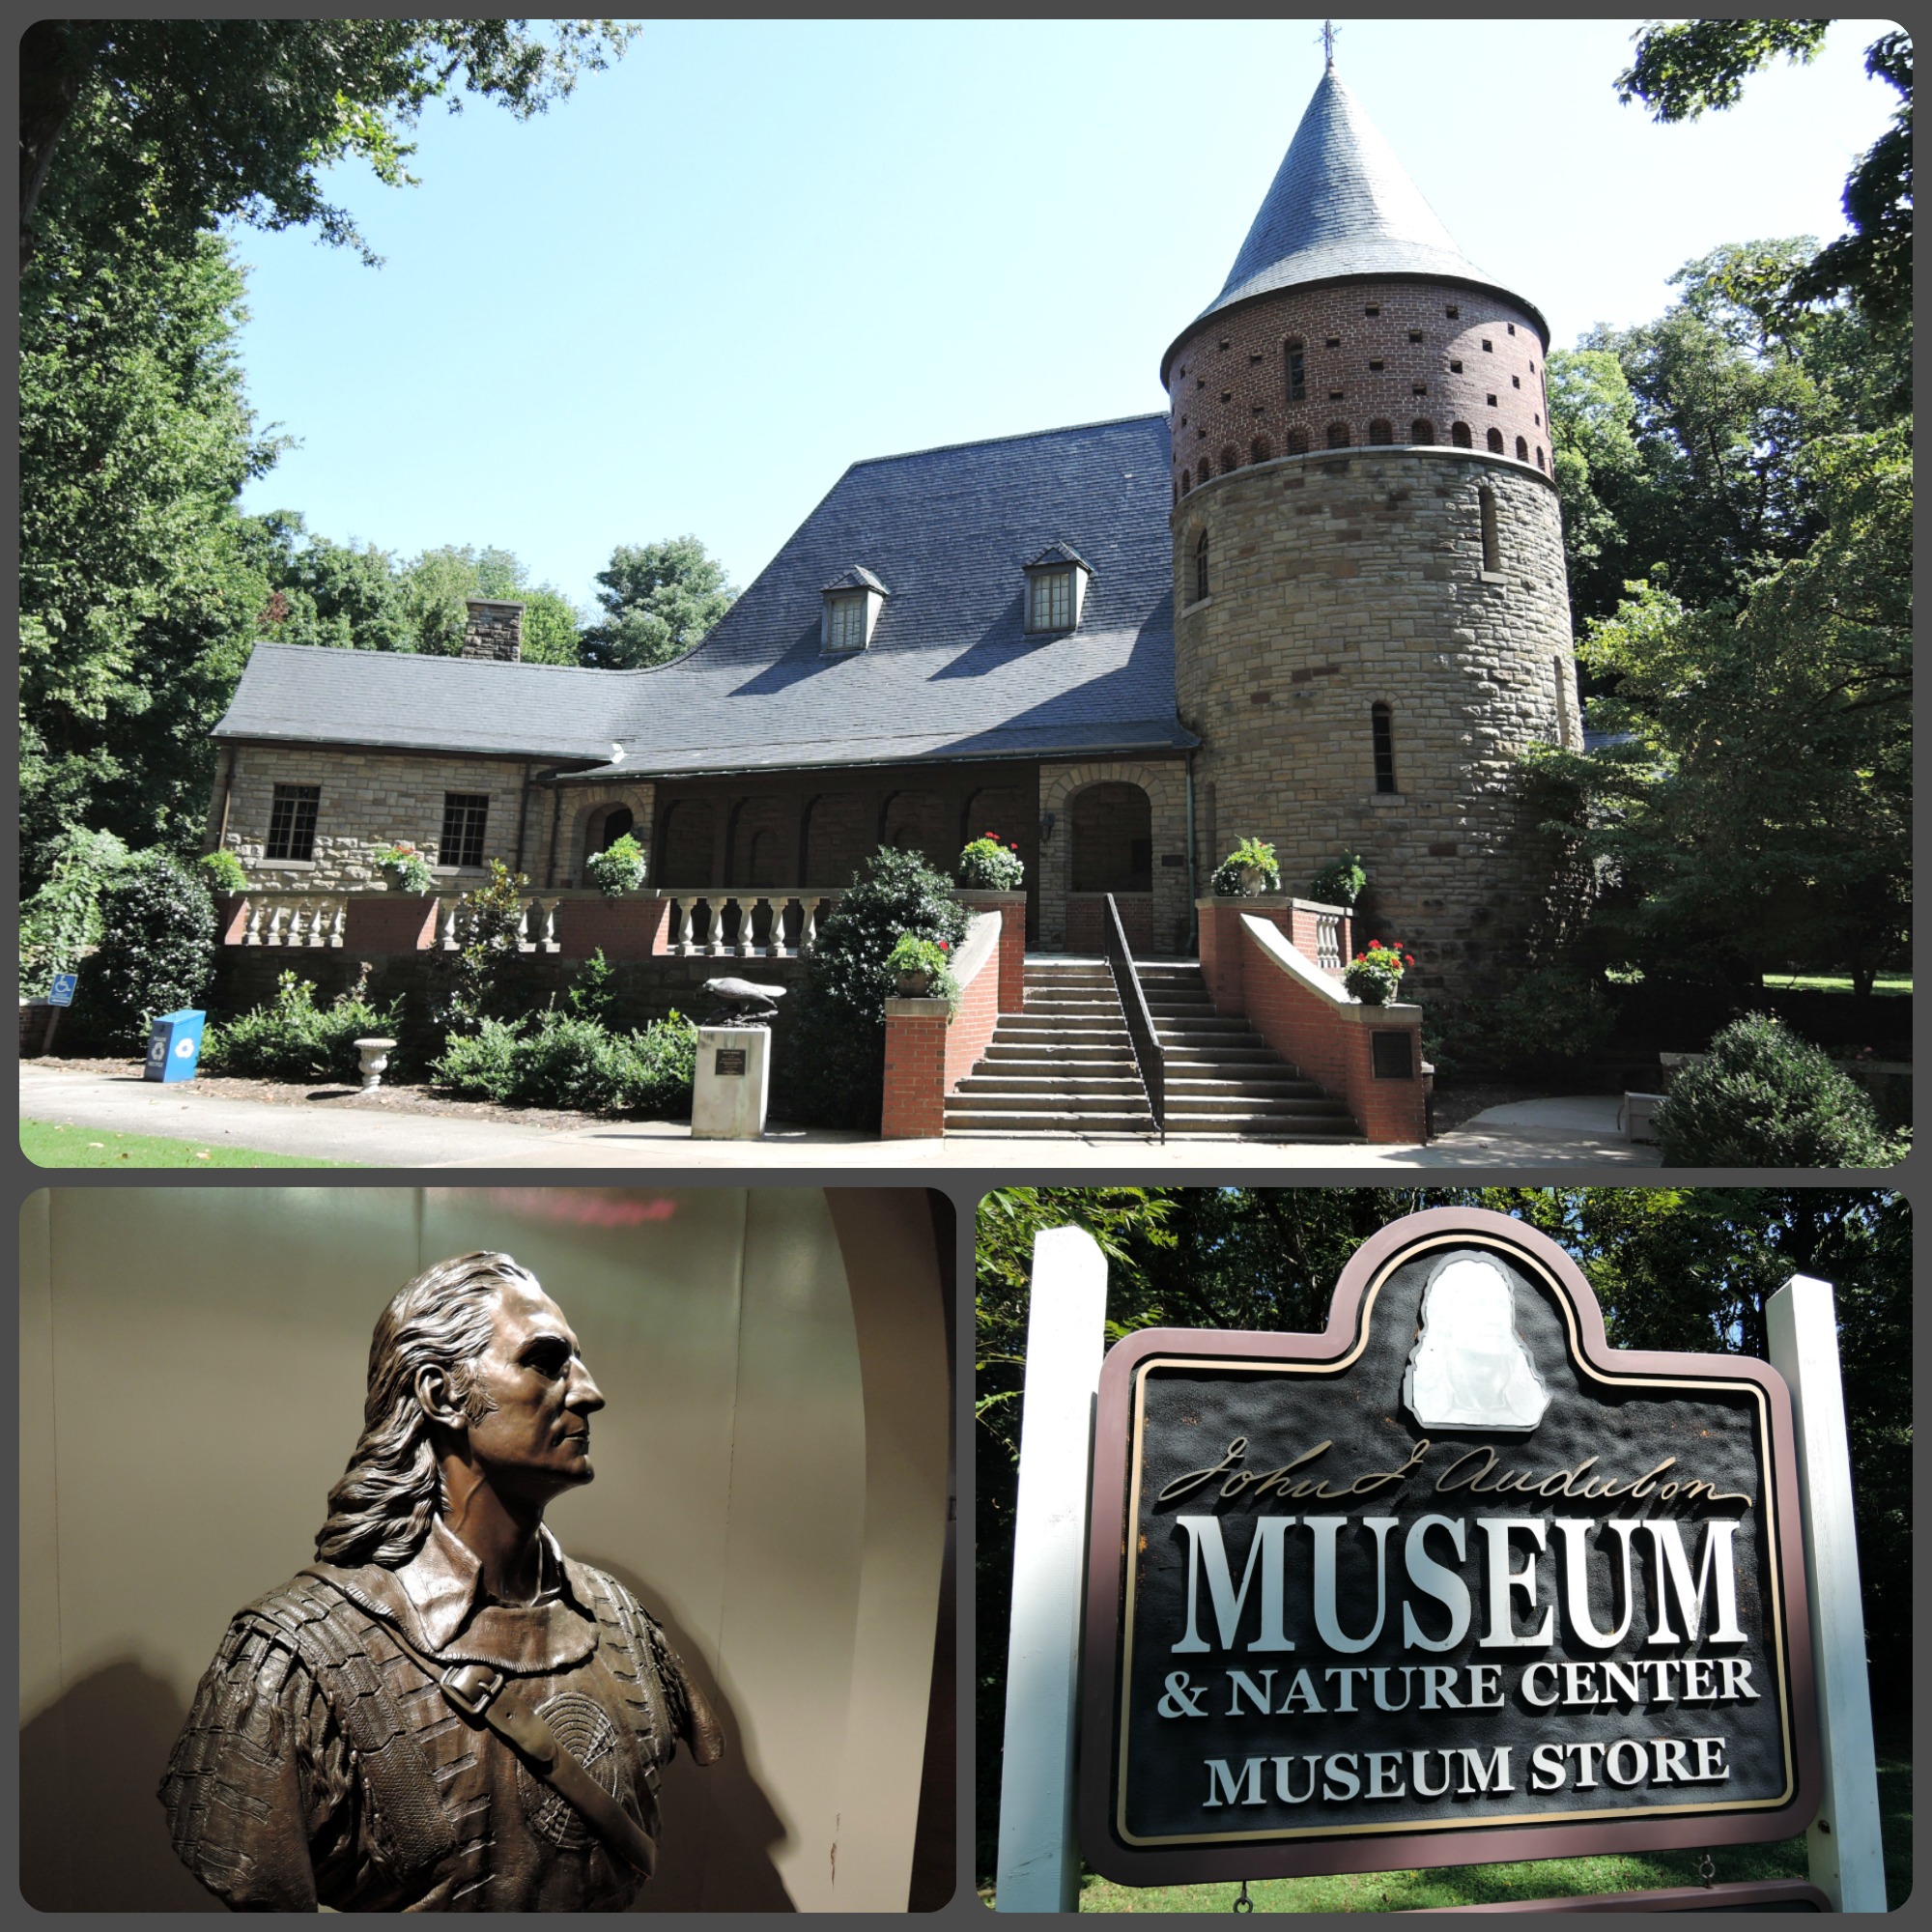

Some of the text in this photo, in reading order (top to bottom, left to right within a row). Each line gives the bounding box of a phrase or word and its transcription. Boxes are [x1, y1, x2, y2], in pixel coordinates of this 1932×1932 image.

[1158, 1436, 1352, 1502] John
[1435, 1446, 1752, 1508] Audubon
[1171, 1514, 1748, 1654] MUSEUM
[1157, 1659, 1761, 1719] & NATURE CENTER
[1203, 1738, 1730, 1807] MUSEUM STORE
